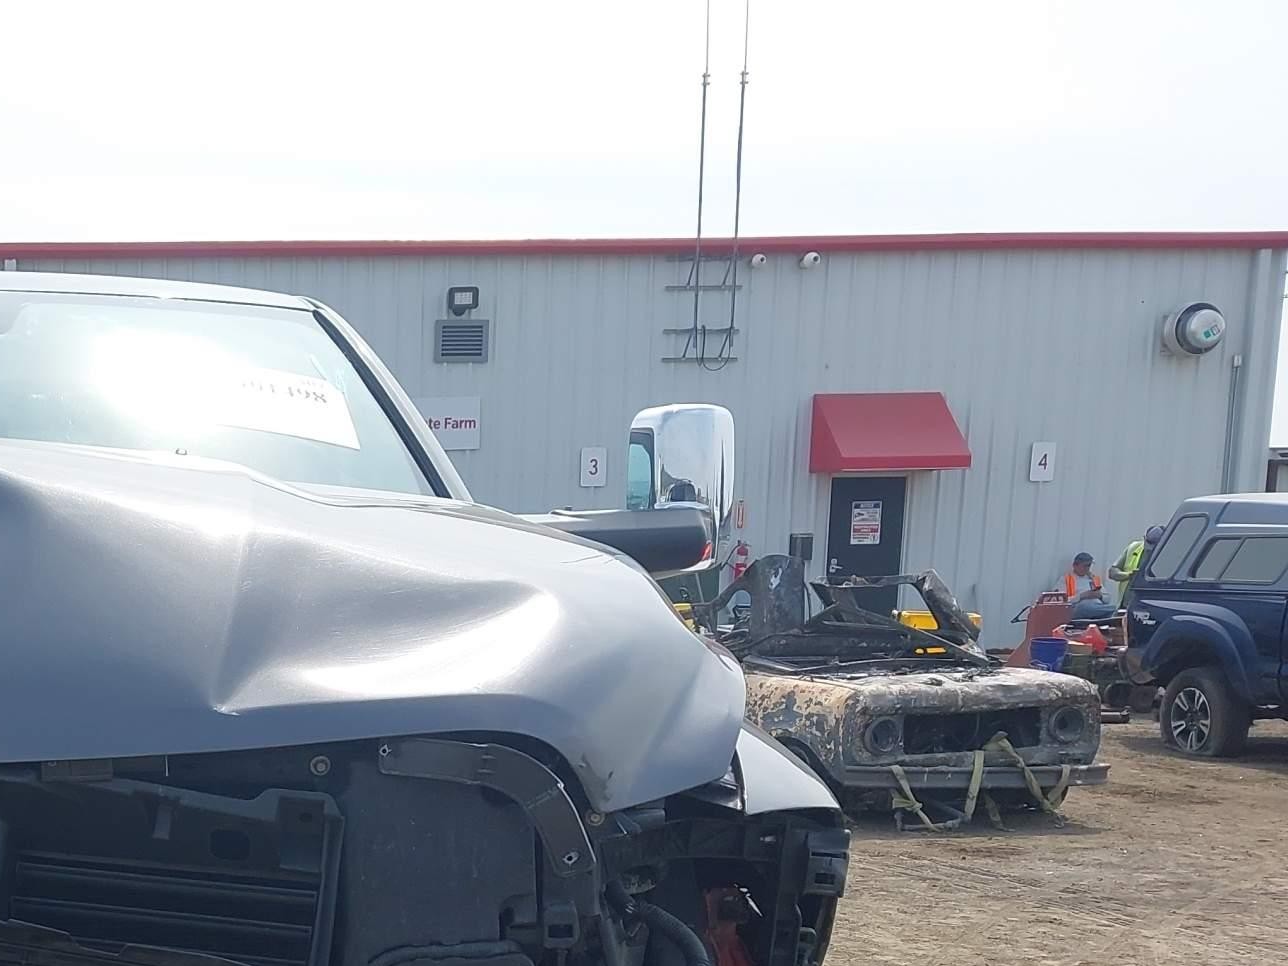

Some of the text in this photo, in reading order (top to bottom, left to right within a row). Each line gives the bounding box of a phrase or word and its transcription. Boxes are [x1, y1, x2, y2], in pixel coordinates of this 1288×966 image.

[426, 417, 476, 430] te Farm
[588, 458, 598, 475] 3
[1037, 453, 1048, 471] 4
